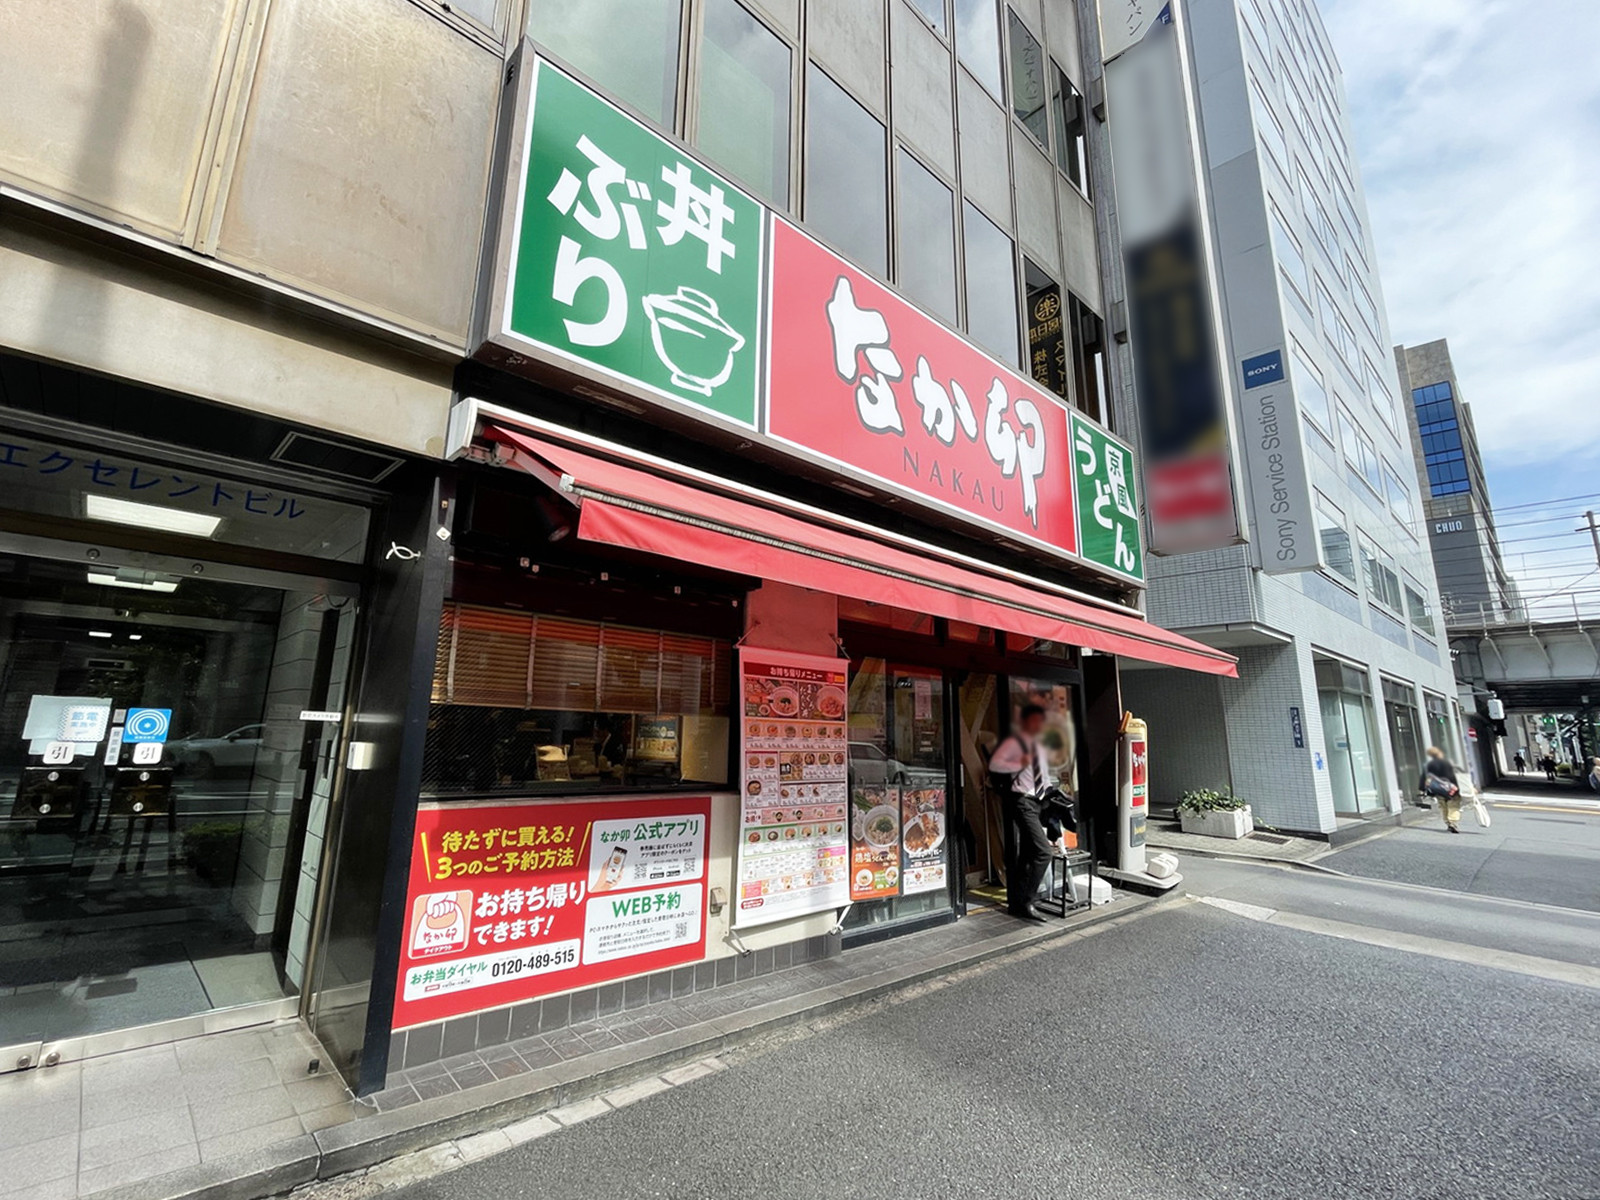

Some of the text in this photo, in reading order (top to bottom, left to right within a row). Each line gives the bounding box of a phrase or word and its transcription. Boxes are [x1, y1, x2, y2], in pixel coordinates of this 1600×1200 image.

[1247, 363, 1278, 377] SONY
[826, 276, 1046, 528] なか卯
[0, 442, 305, 519] エクセレントビル
[903, 447, 1004, 513] NAKAU
[1258, 394, 1297, 561] Sony Service Station
[1076, 426, 1135, 572] うどん
[1435, 520, 1463, 534] CHUO
[600, 819, 699, 843] なか卯 公式アプリ
[434, 847, 575, 881] 3つのご予約方法
[474, 879, 587, 918] お持ち帰り
[612, 891, 681, 918] WEB予約
[410, 961, 488, 986] お弁当ダイヤル
[491, 948, 575, 977] 0120-489-515
